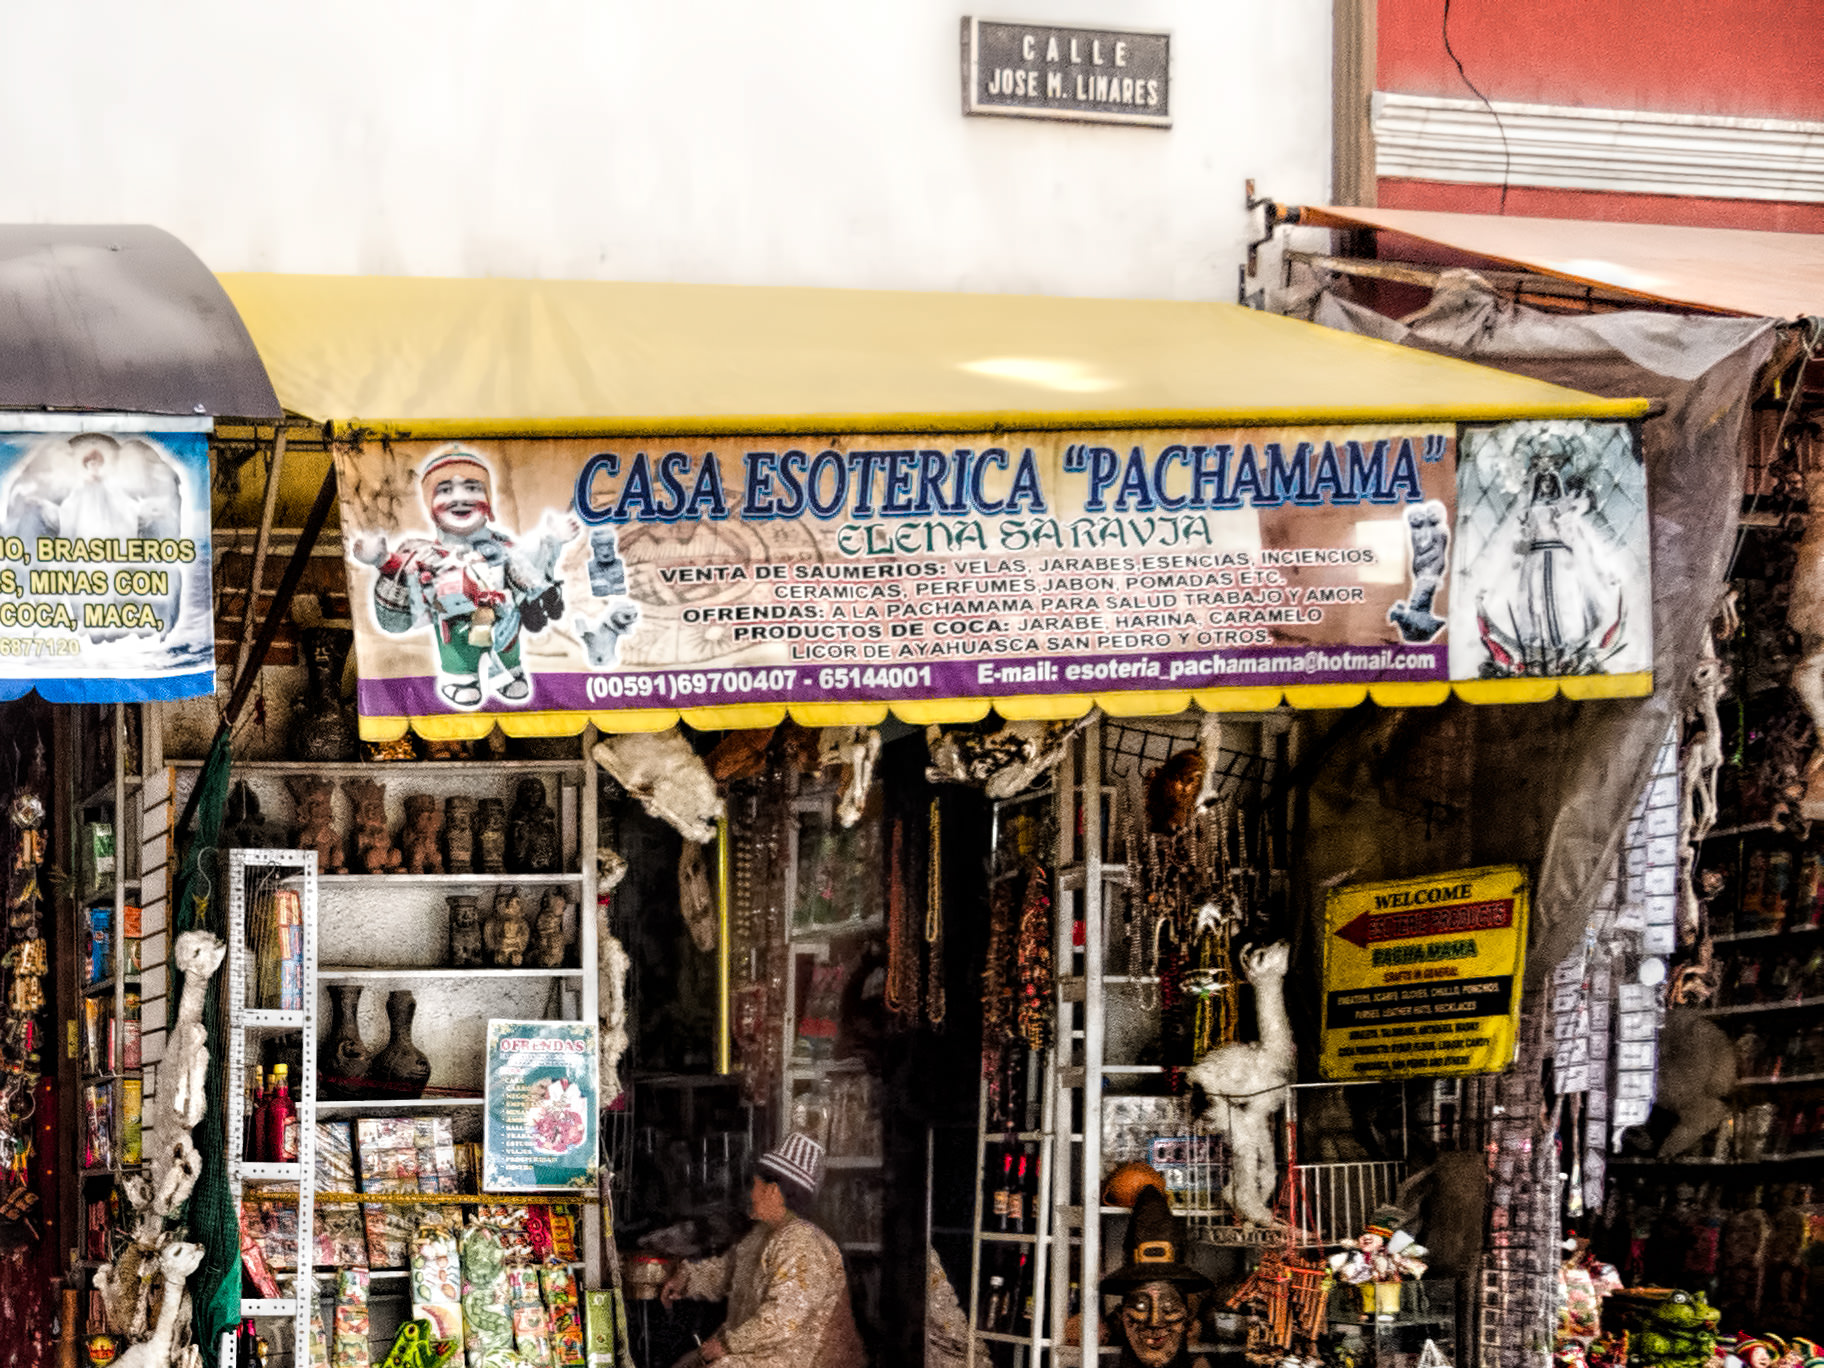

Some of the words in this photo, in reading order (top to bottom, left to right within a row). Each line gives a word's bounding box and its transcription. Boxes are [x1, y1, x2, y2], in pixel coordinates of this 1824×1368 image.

[1022, 34, 1127, 67] CALLE
[988, 68, 1039, 97] JOSE
[1047, 71, 1068, 98] M.
[1077, 74, 1159, 106] LINARES
[576, 451, 729, 526] CASA
[740, 448, 1048, 521] ESOTERICA
[37, 538, 196, 563] BRASILEROS
[837, 518, 988, 557] ELENA
[660, 566, 748, 584] VENTA
[755, 564, 786, 581] DE
[795, 561, 946, 580] SAUMERIOS:
[954, 558, 1031, 575] VELAS,
[1261, 549, 1379, 566] INCIENCIOS,
[30, 571, 108, 595] MINAS
[114, 571, 168, 595] CON
[774, 582, 908, 600] CERAMICAS,
[1127, 572, 1233, 591] POMADAS
[1240, 571, 1286, 586] ETC.
[0, 602, 78, 631] COCA,
[84, 603, 164, 631] MACA,
[682, 604, 825, 623] OFRENDAS:
[833, 604, 846, 619] A
[853, 602, 879, 618] LA
[887, 599, 1034, 618] PACHAMAMA
[1042, 596, 1100, 612] PARA
[1106, 594, 1177, 609] SALUD
[1184, 590, 1282, 607] TRABAJO
[1288, 589, 1299, 601] Y
[1306, 587, 1364, 602] AMOR
[733, 625, 882, 642] PRODUCTOS
[892, 622, 923, 638] DE
[933, 620, 1010, 636] COCA:
[1017, 616, 1109, 633] JARABE,
[1116, 612, 1202, 629] HARINA,
[1210, 608, 1323, 625] CARAMELO
[792, 644, 857, 660] LICOR
[863, 643, 891, 659] DE
[898, 638, 1040, 657] AYAHUASCA
[1047, 636, 1090, 650] SAN
[1097, 633, 1171, 650] PEDRO
[1179, 633, 1190, 646] Y
[1197, 629, 1272, 645] OTROS.
[977, 660, 1059, 685] E-mail:
[1064, 650, 1436, 681] esoteria_pachamama@hotmail.com
[586, 668, 798, 704] (00591)69700407
[819, 665, 933, 690] 65144001
[1375, 884, 1473, 910] WELCOME
[1431, 903, 1506, 931] PRODUCTS
[1427, 939, 1478, 962] MAMA
[500, 1038, 586, 1053] OFRENDAS
